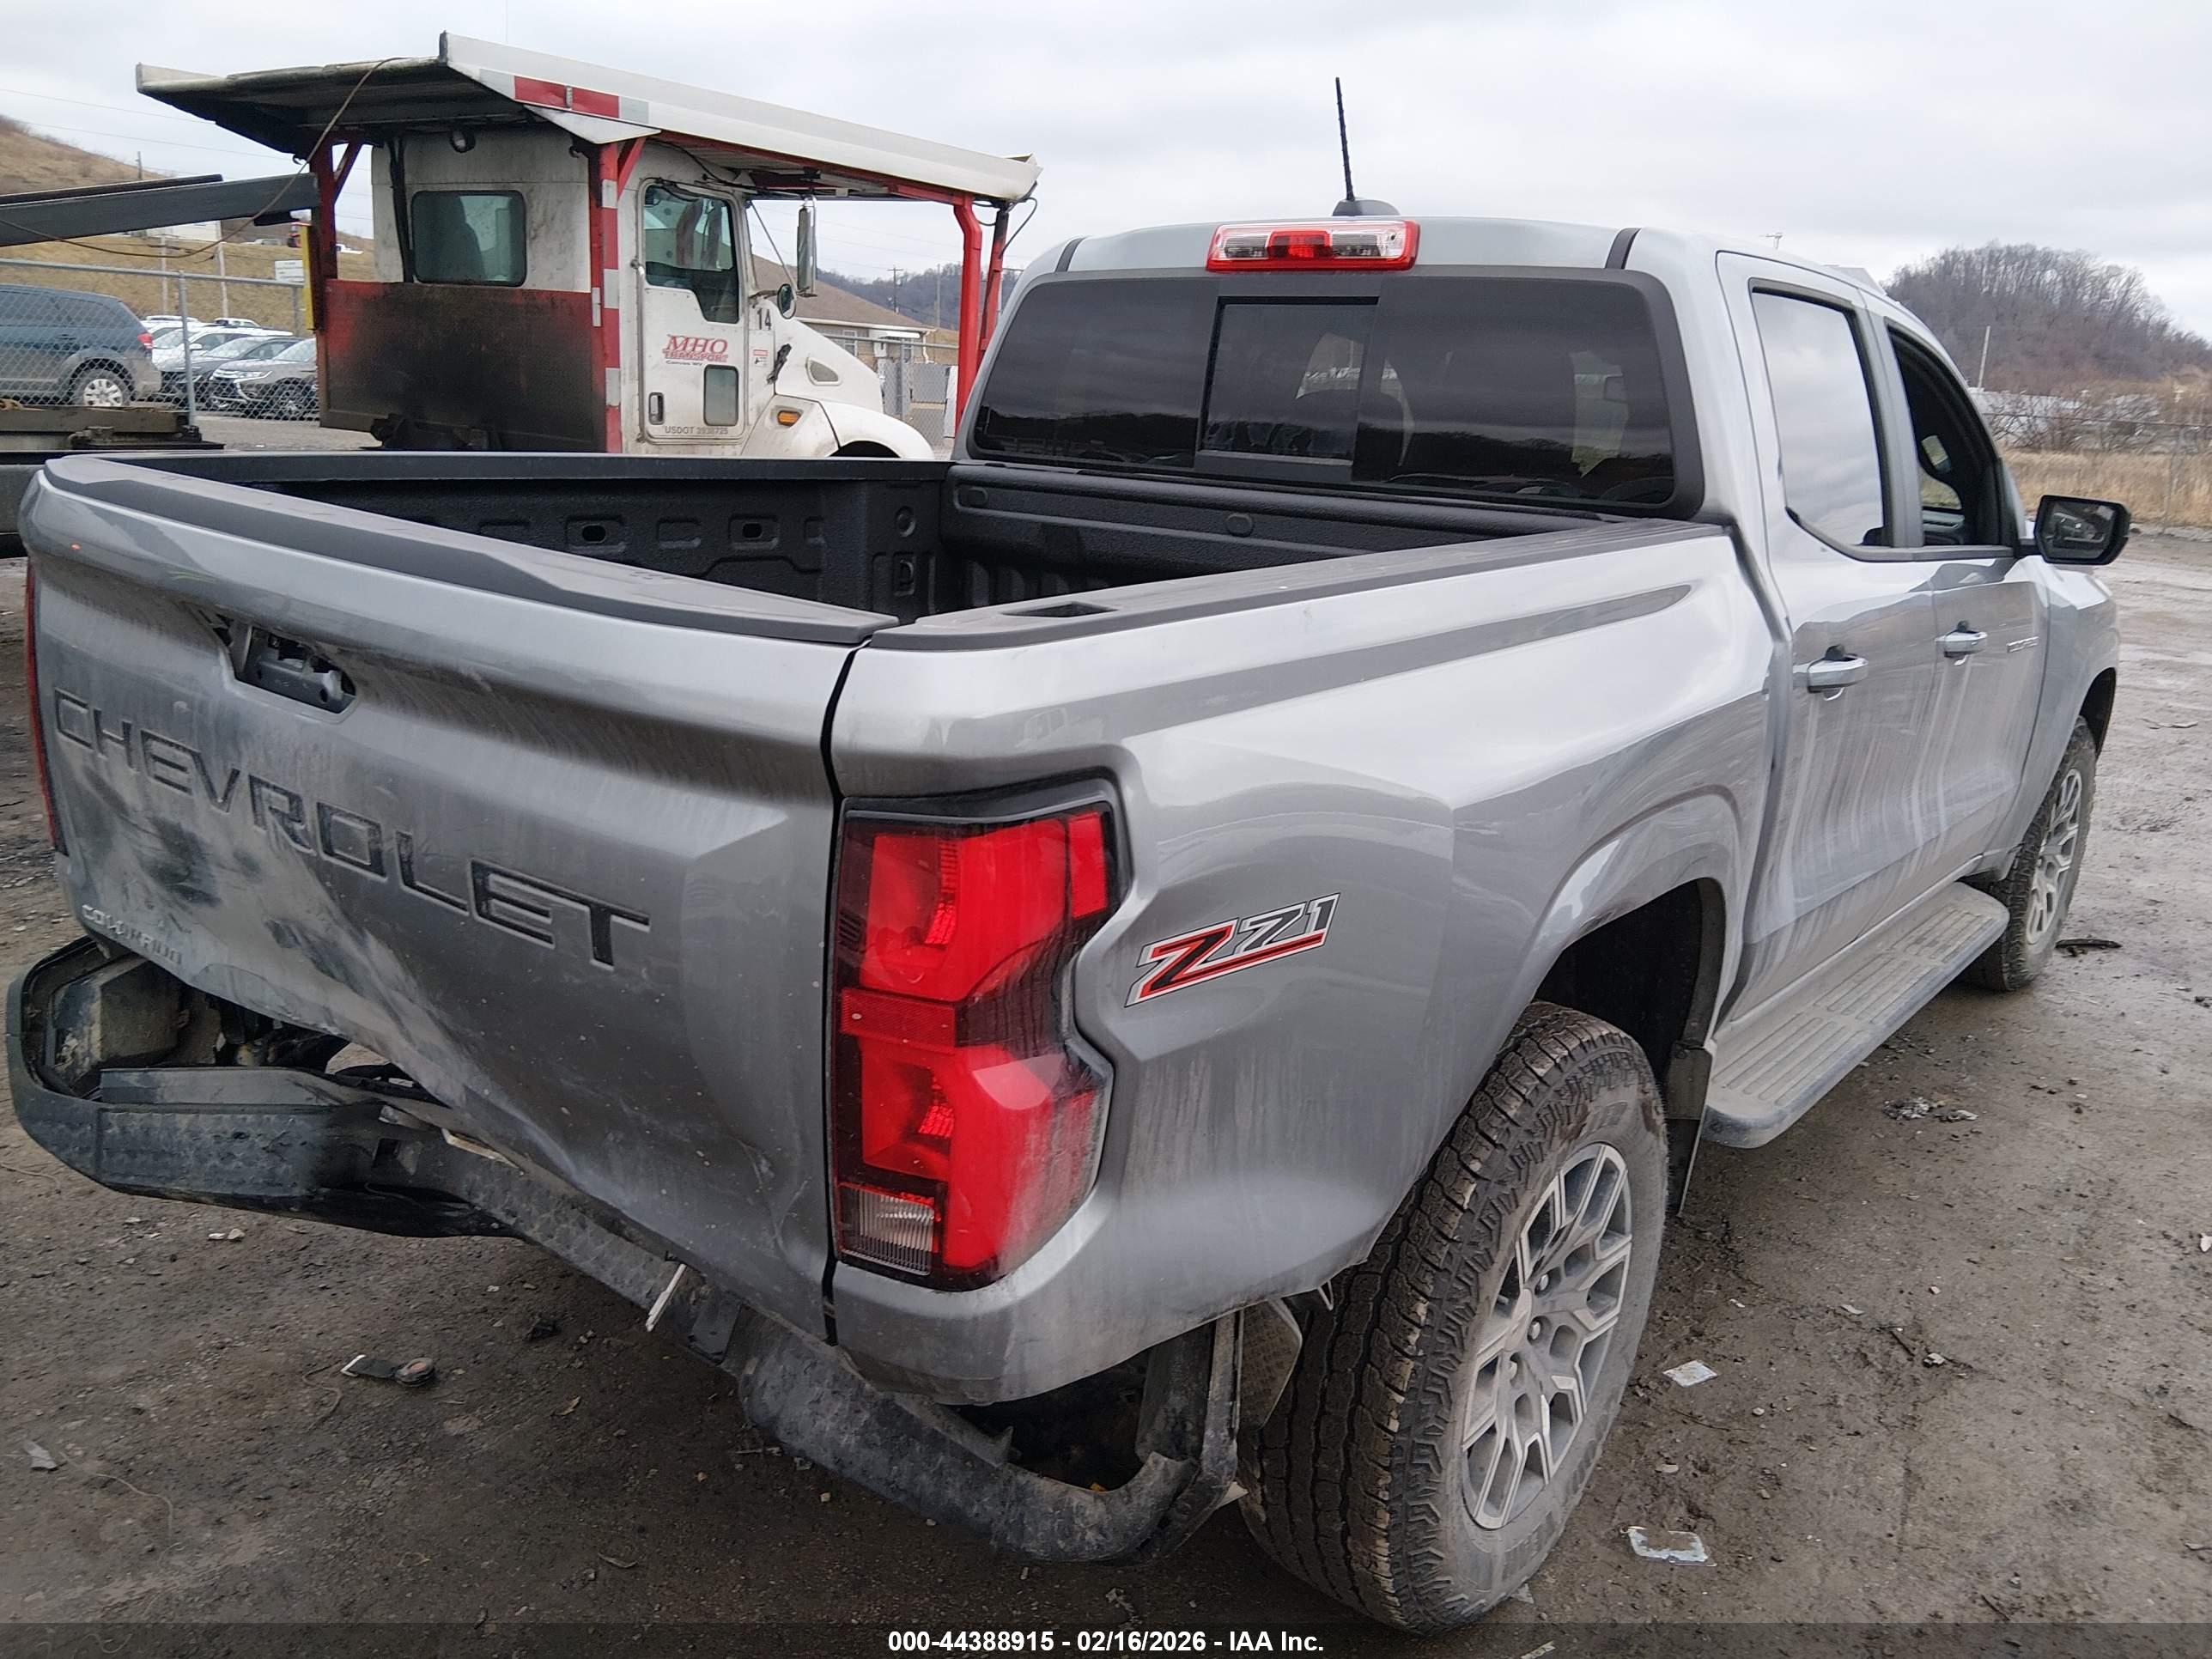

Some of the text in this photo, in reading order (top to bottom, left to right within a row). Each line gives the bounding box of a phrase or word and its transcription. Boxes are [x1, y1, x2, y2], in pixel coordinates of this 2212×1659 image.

[757, 307, 772, 331] 14
[662, 348, 729, 363] TRANSPORT
[665, 334, 728, 355] MHO
[665, 426, 694, 434] USDOT
[56, 687, 651, 972] CHEVROLET
[1124, 892, 1341, 1007] Z71
